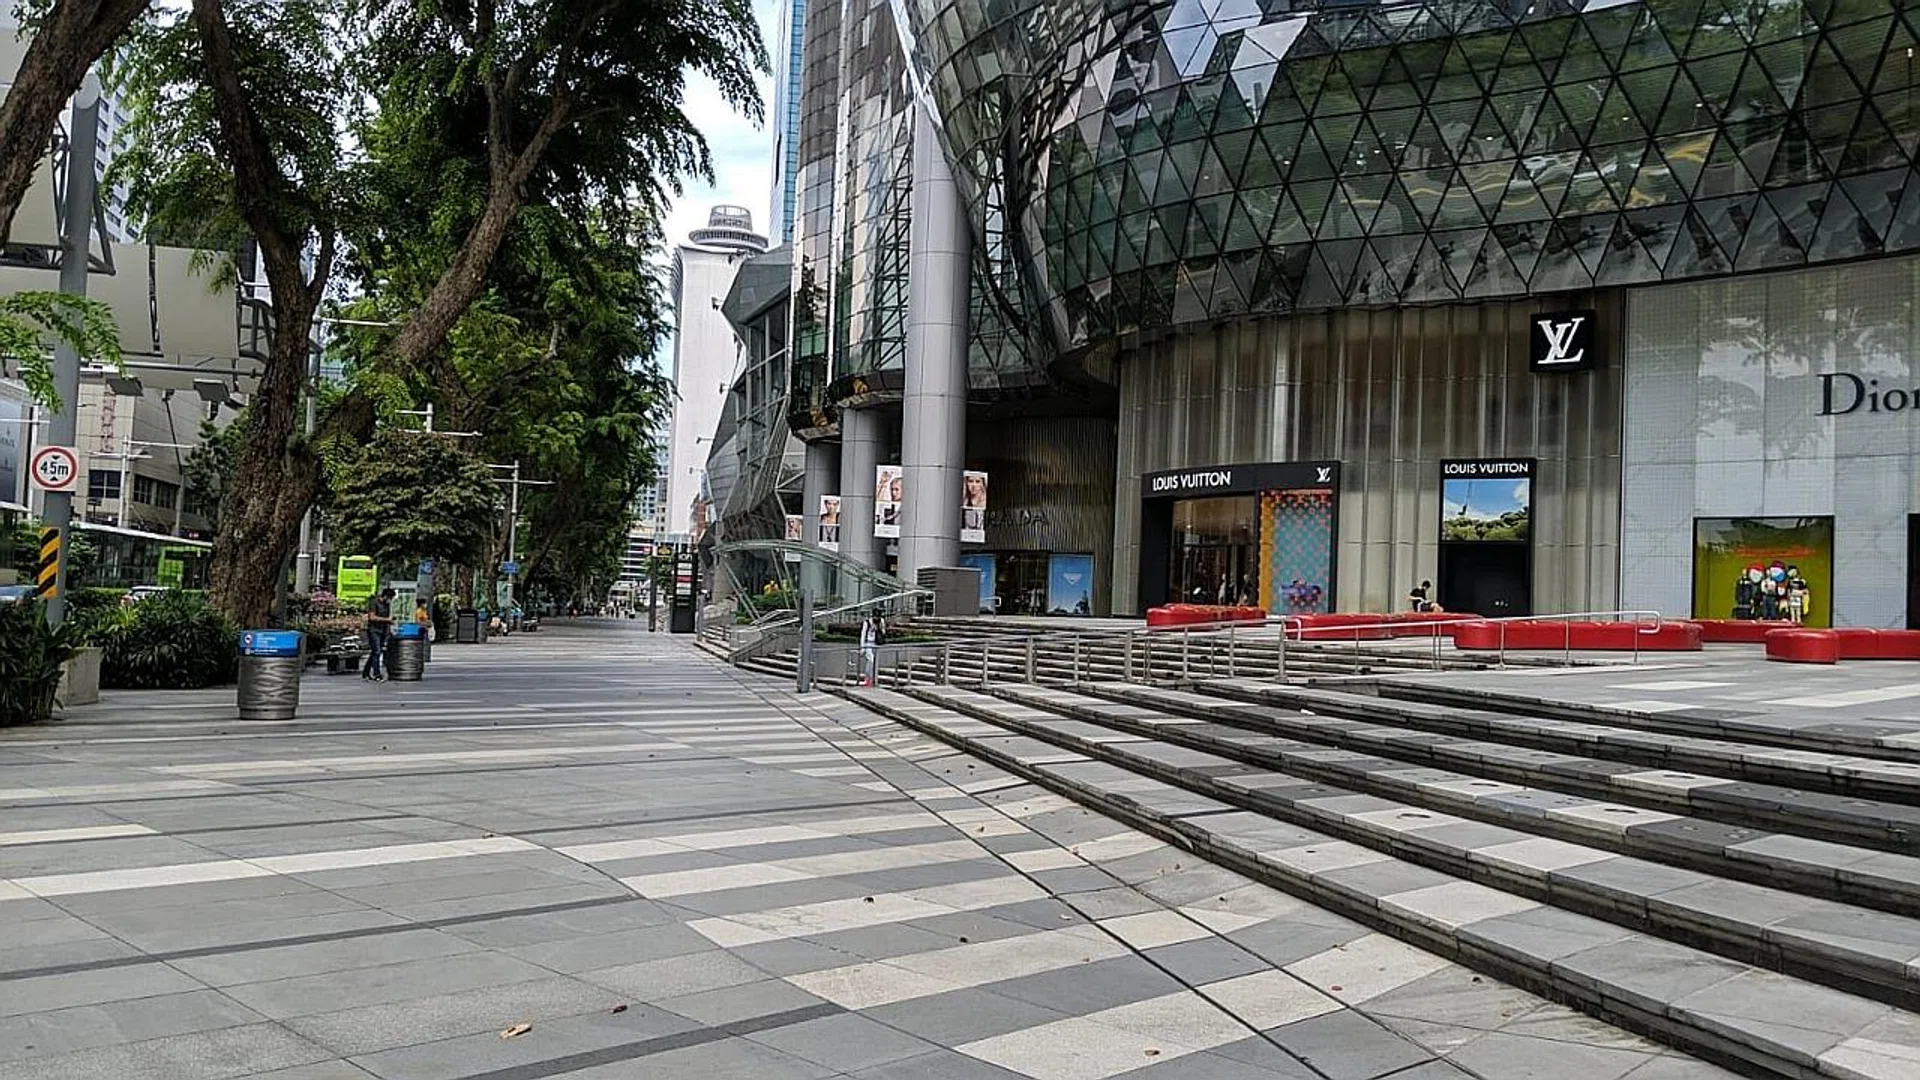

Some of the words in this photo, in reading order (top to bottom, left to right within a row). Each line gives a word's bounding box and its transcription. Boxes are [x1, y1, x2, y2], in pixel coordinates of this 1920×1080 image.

[1444, 463, 1477, 474] LOUIS
[1479, 462, 1529, 474] VUITTON
[1152, 475, 1179, 492] LOUIS
[1180, 471, 1231, 489] VUITTON
